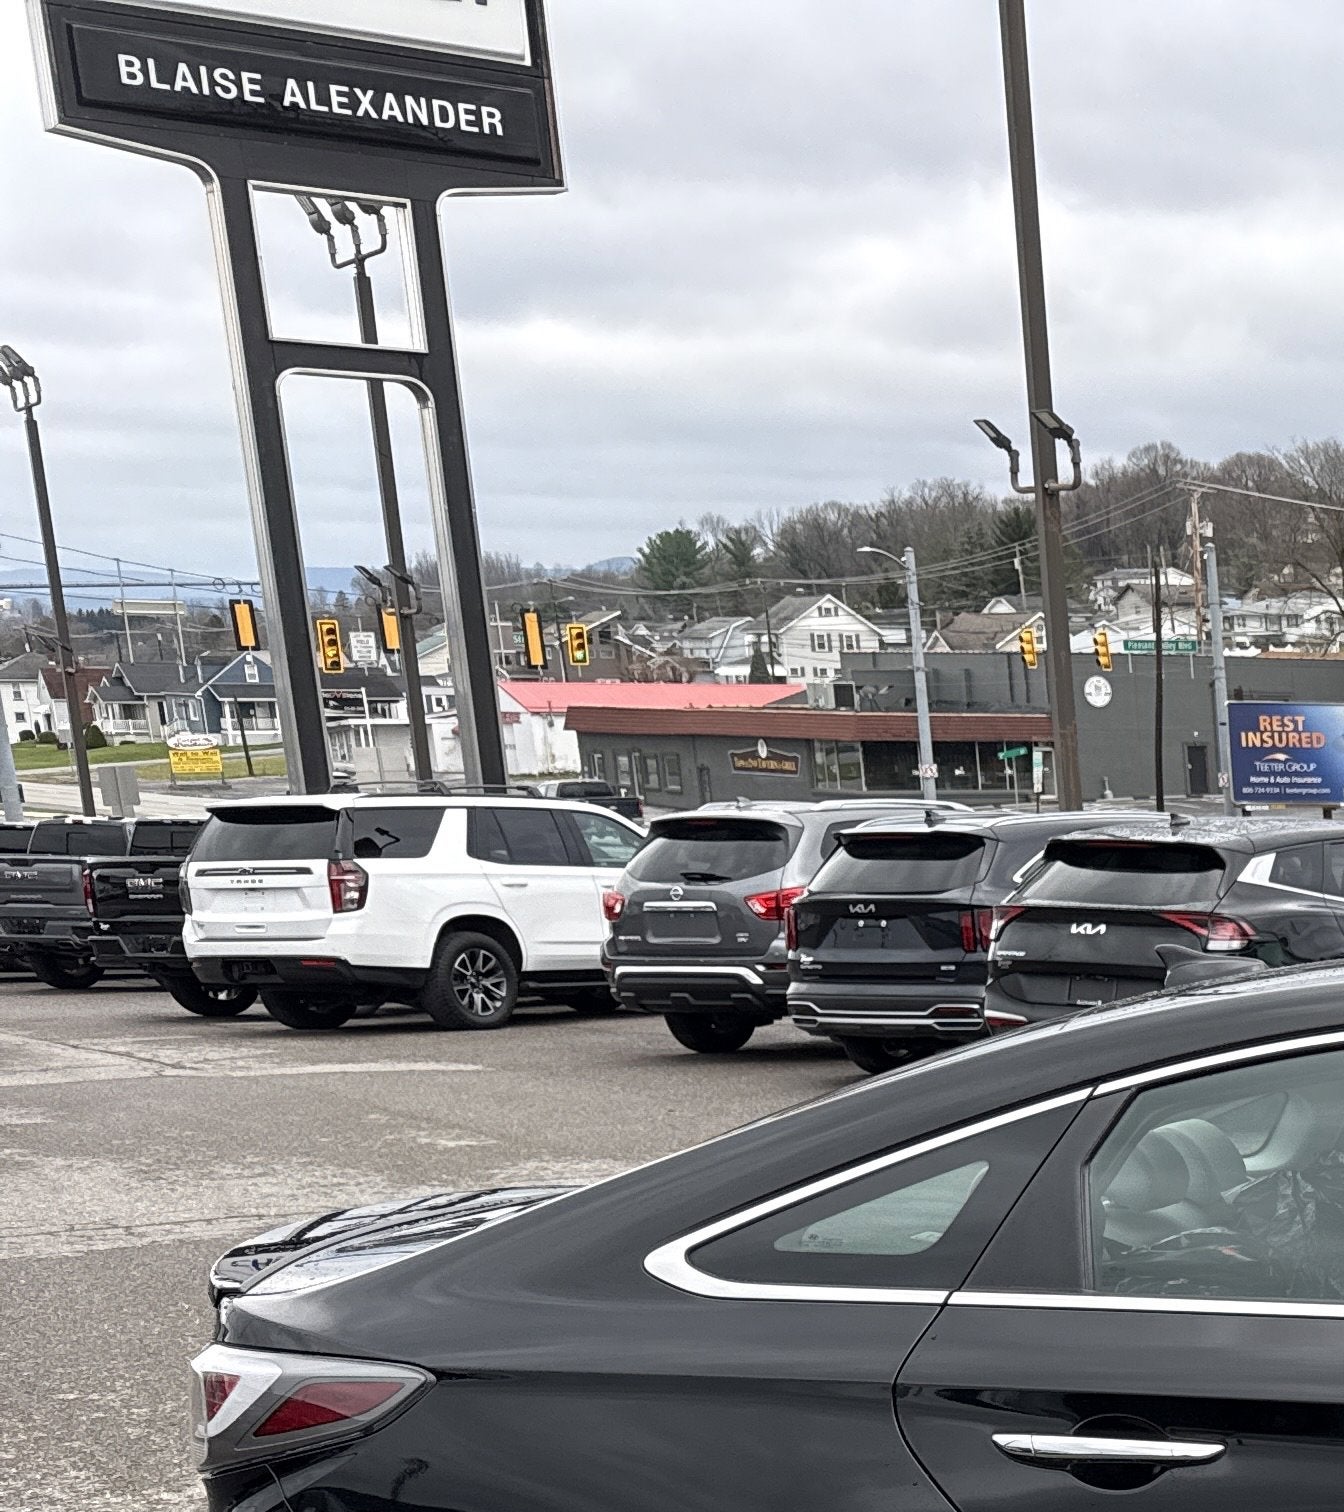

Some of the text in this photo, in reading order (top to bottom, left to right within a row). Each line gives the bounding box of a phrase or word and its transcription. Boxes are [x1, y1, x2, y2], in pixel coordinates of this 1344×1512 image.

[117, 53, 504, 137] BLAISE ALEXANDER
[1258, 715, 1306, 732] REST
[1240, 731, 1327, 749] INSURED
[1254, 762, 1318, 772] TEETER GROUP
[1249, 776, 1269, 784] Home
[1276, 776, 1291, 784] Auto
[1292, 776, 1322, 784] Insurance
[126, 878, 164, 888] GMC
